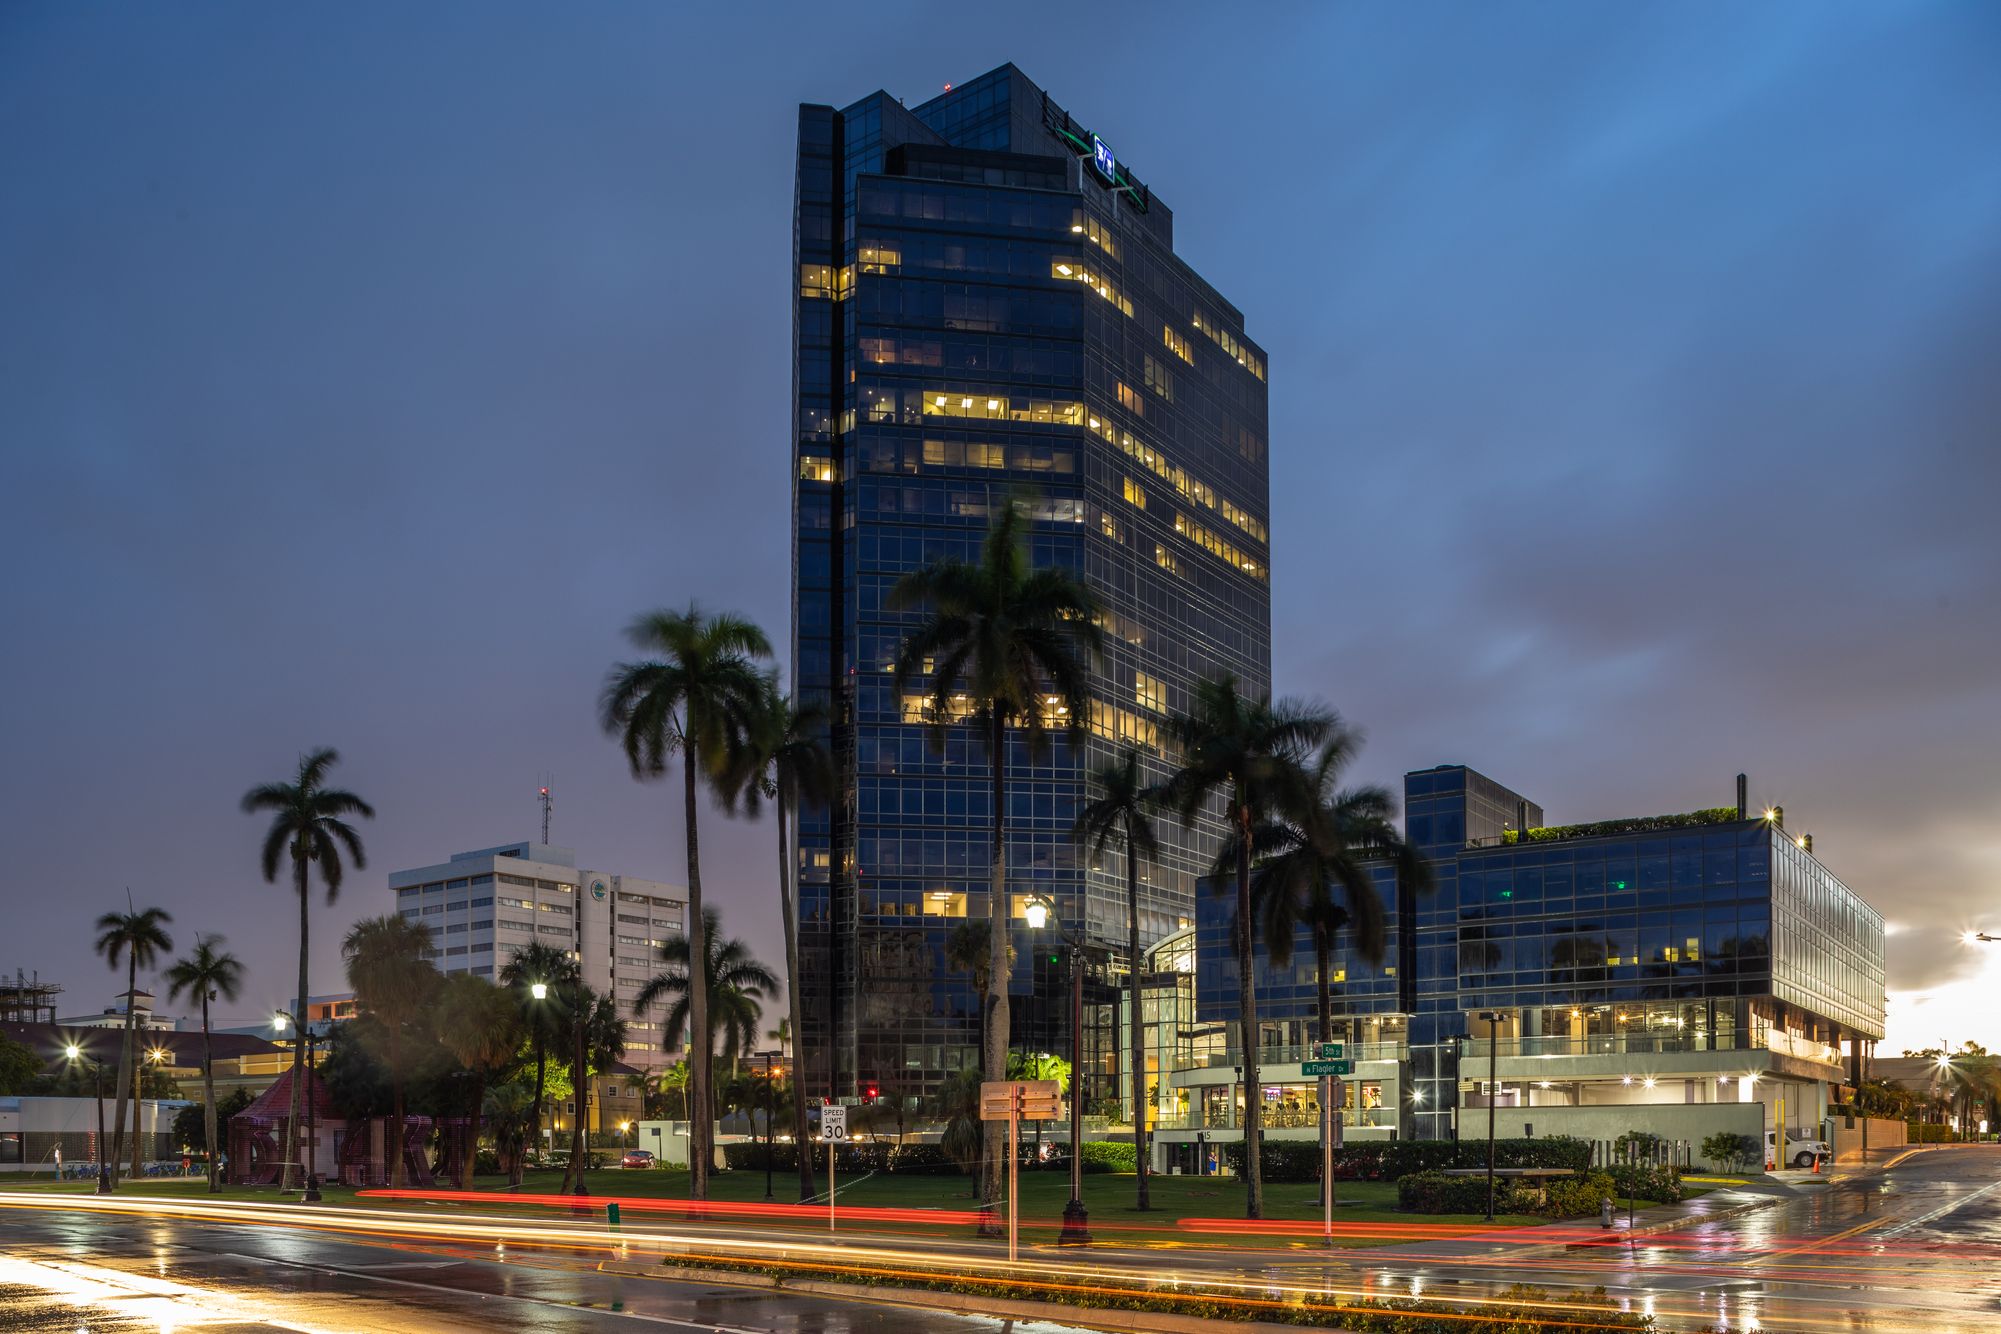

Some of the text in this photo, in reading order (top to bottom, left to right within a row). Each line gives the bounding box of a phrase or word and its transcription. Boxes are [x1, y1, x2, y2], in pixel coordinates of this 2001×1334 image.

[1325, 1046, 1335, 1055] 5th
[1312, 1064, 1335, 1075] Flagler
[824, 1125, 844, 1139] 30
